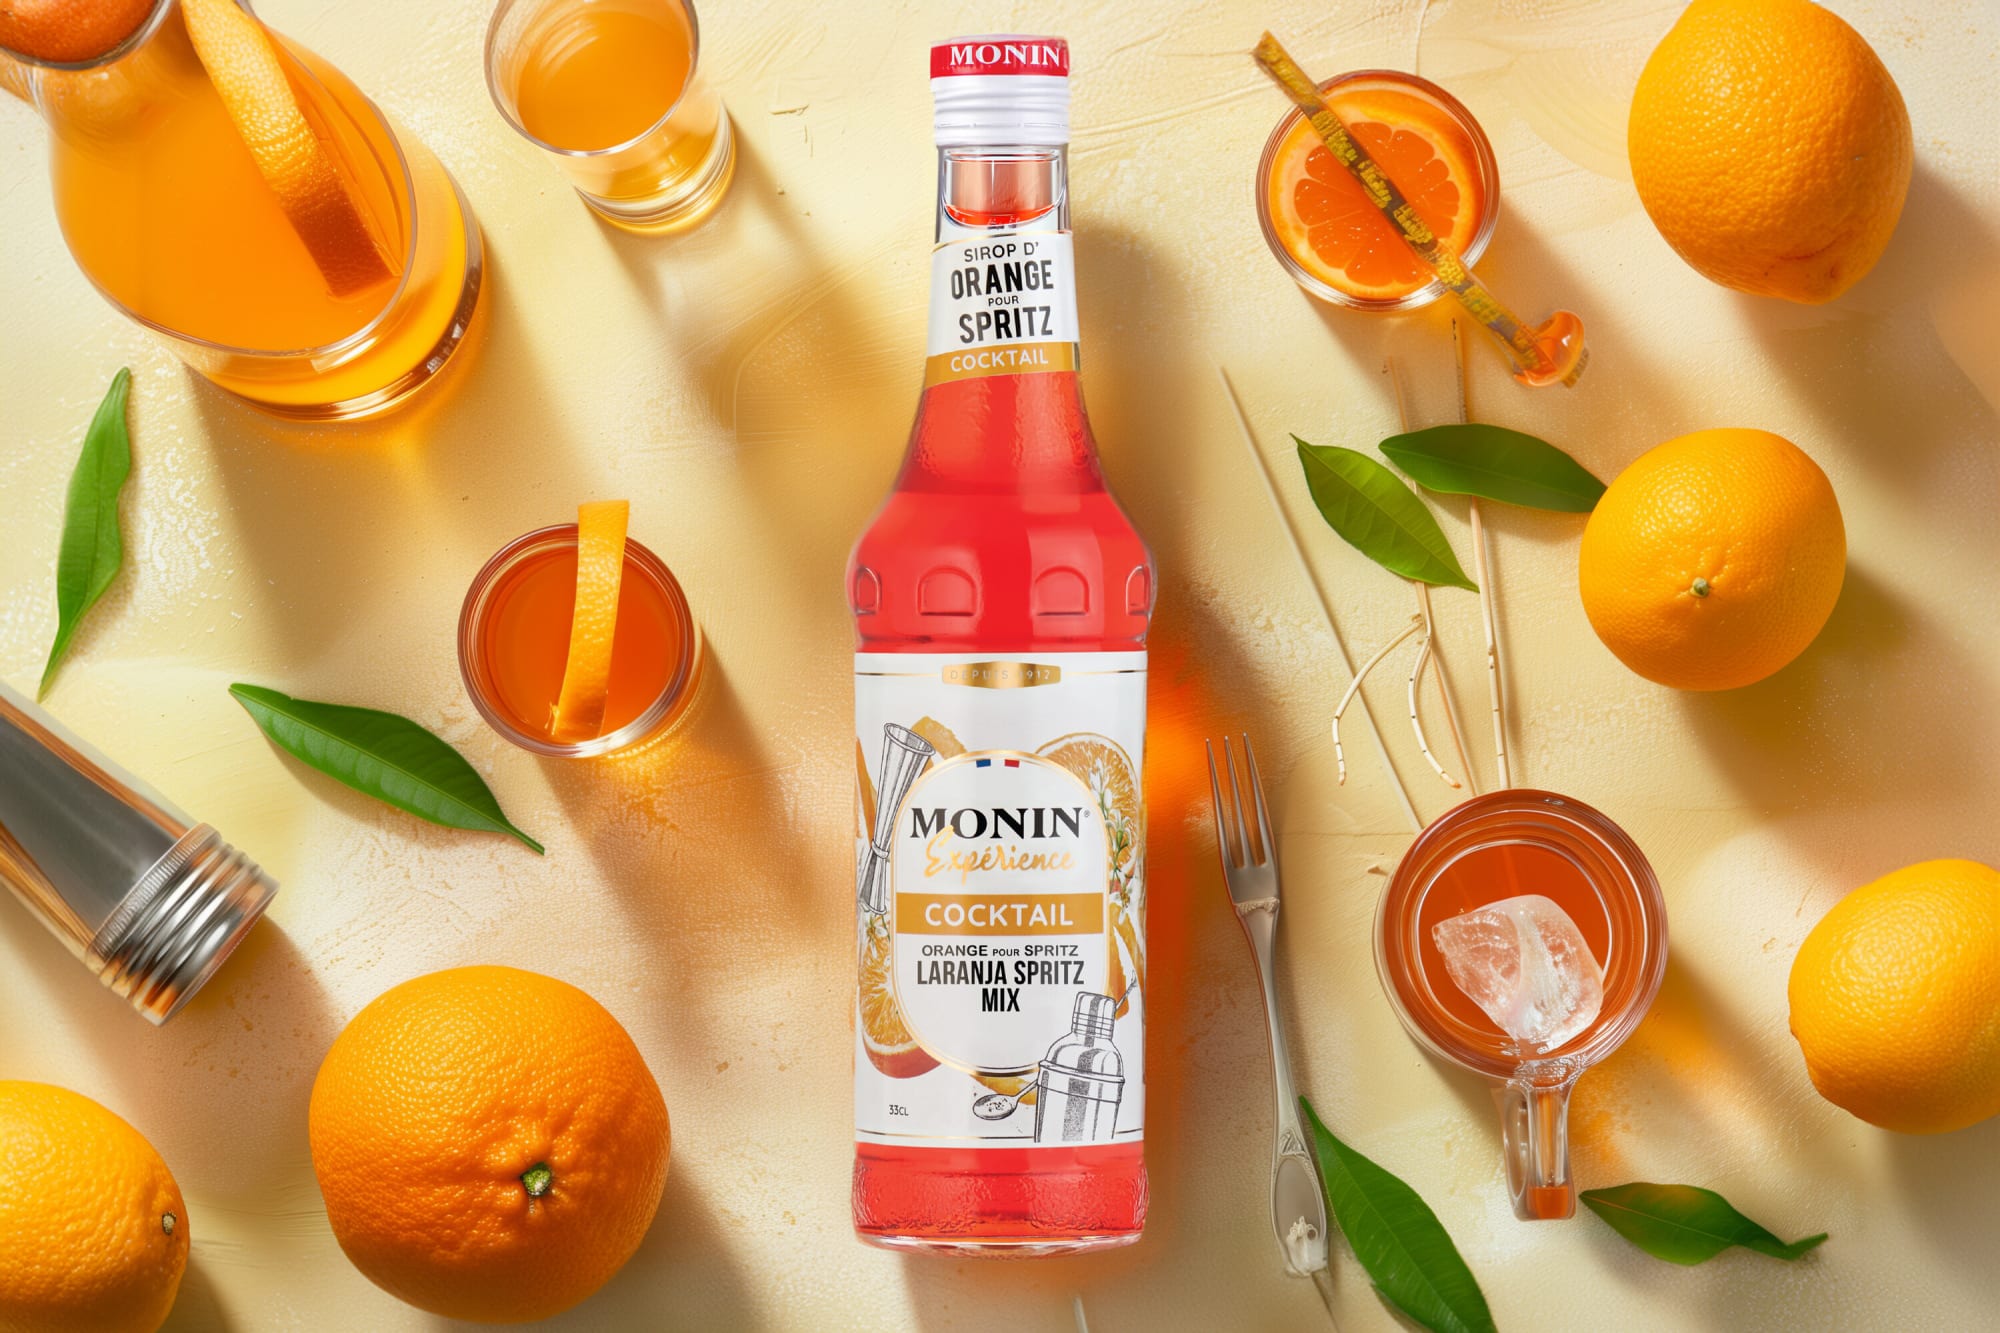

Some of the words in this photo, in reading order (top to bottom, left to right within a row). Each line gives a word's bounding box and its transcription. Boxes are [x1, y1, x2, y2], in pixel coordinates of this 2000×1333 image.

[950, 44, 1060, 66] MONIN
[964, 244, 1017, 262] SIROP
[951, 260, 1054, 300] ORANGE
[988, 295, 1019, 307] POUR
[959, 305, 1053, 344] SPRITZ
[951, 348, 1048, 373] COCKTAIL
[950, 670, 1009, 680] DEPUIS
[924, 825, 1075, 885] Expérience
[925, 903, 1073, 927] COCKTAIL
[922, 944, 988, 957] ORANGE
[992, 948, 1020, 957] POUR
[1024, 944, 1079, 957] SPRITZ
[917, 960, 1007, 985] LARANJA
[1014, 960, 1084, 985] SPRITZ
[982, 988, 1020, 1012] MIX
[889, 1104, 909, 1116] 33CL
